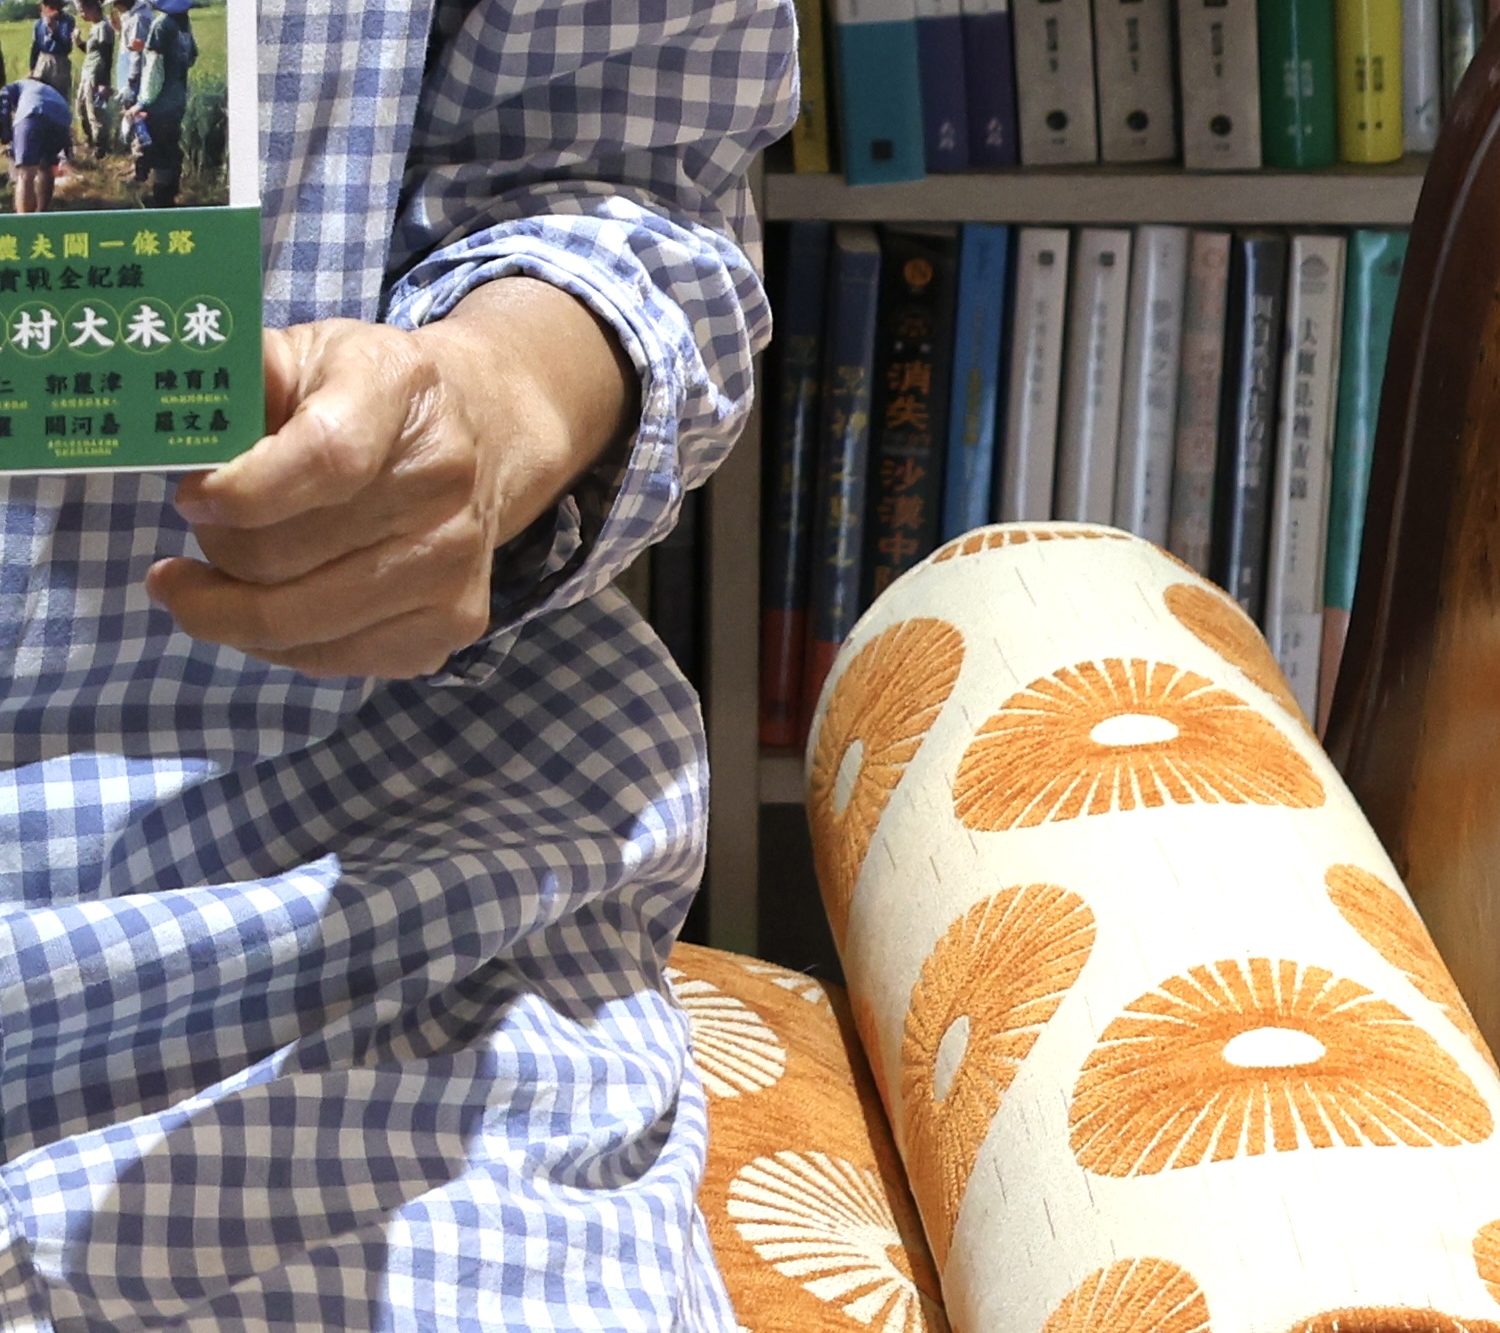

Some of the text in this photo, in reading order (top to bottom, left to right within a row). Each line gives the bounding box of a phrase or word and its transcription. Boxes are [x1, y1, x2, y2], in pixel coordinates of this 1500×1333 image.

[876, 360, 932, 595] 消失 沙漠中
